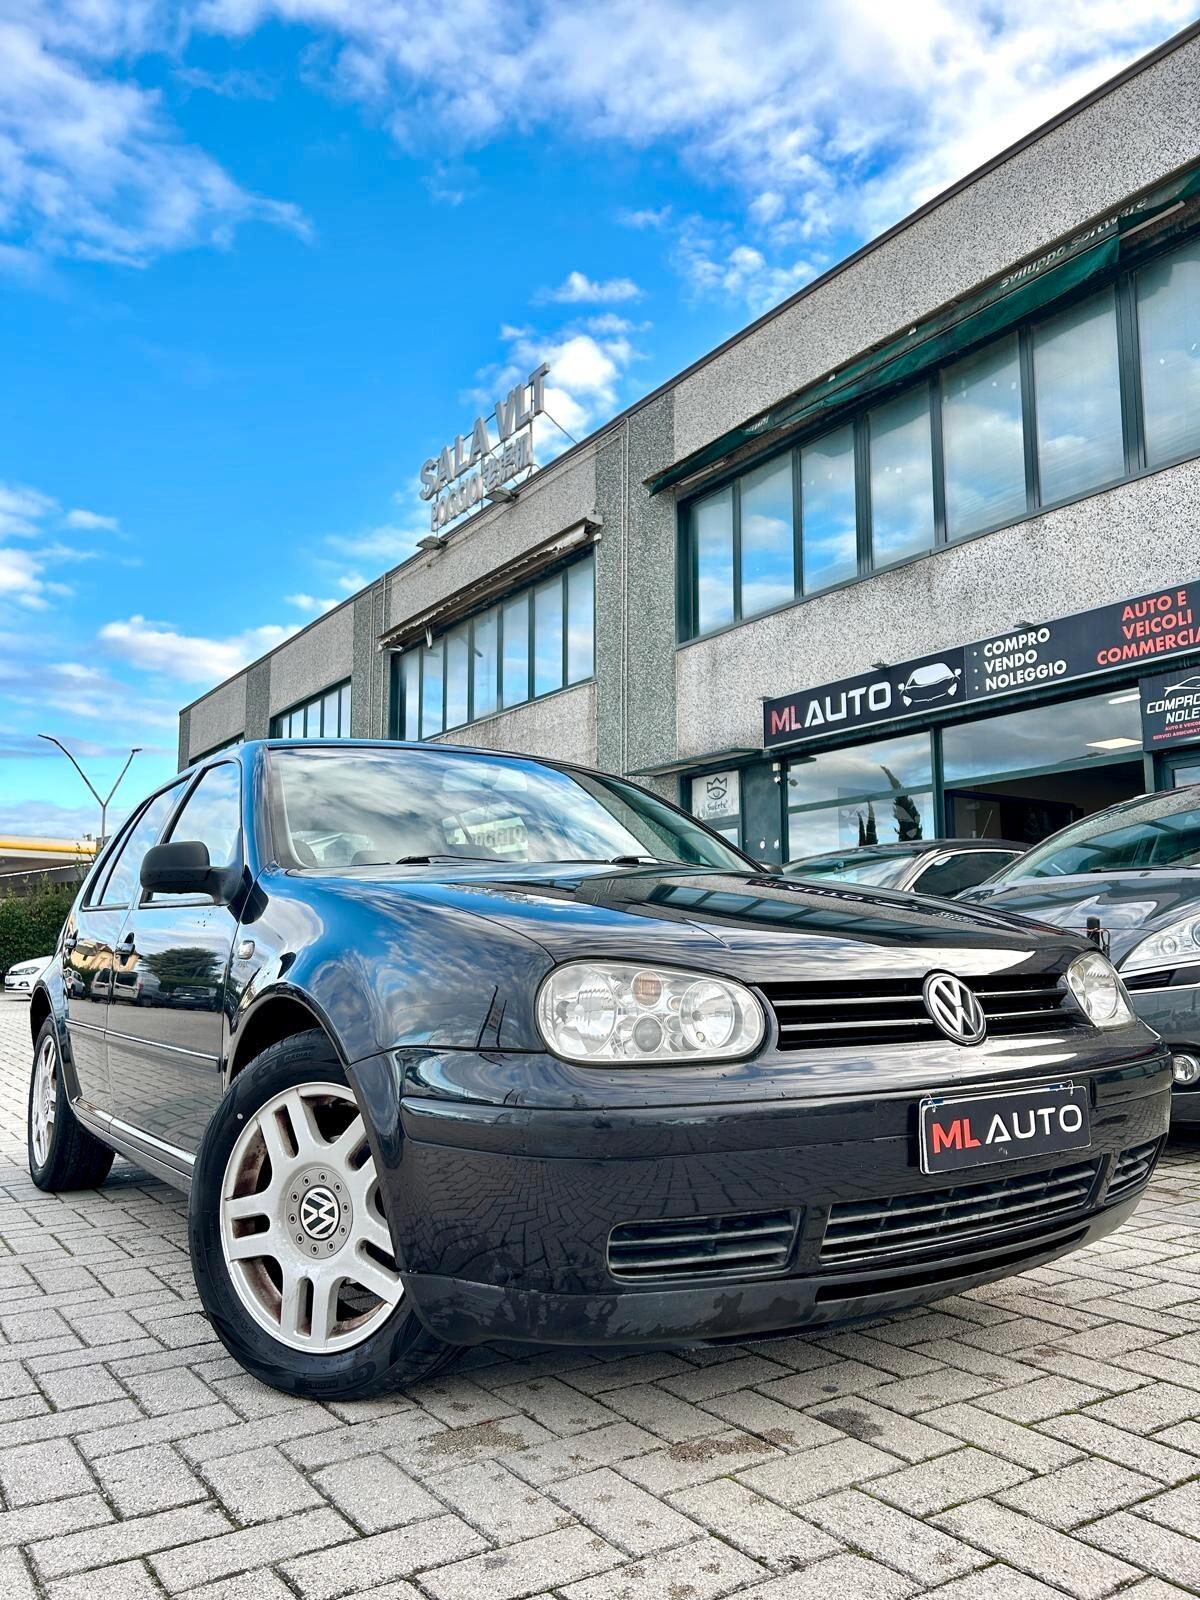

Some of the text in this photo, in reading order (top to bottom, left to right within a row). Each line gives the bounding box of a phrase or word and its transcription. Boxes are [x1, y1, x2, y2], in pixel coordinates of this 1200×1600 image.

[419, 362, 550, 500] SALA VLT
[1122, 590, 1187, 622] AUTO E
[1122, 609, 1193, 640] VEICOLI
[984, 627, 1050, 657] COMPRO
[984, 649, 1038, 674] VENDO
[985, 659, 1067, 692] NOLEGGIO
[771, 681, 892, 735] ML AUTO
[932, 1104, 1082, 1153] ML AUTO
